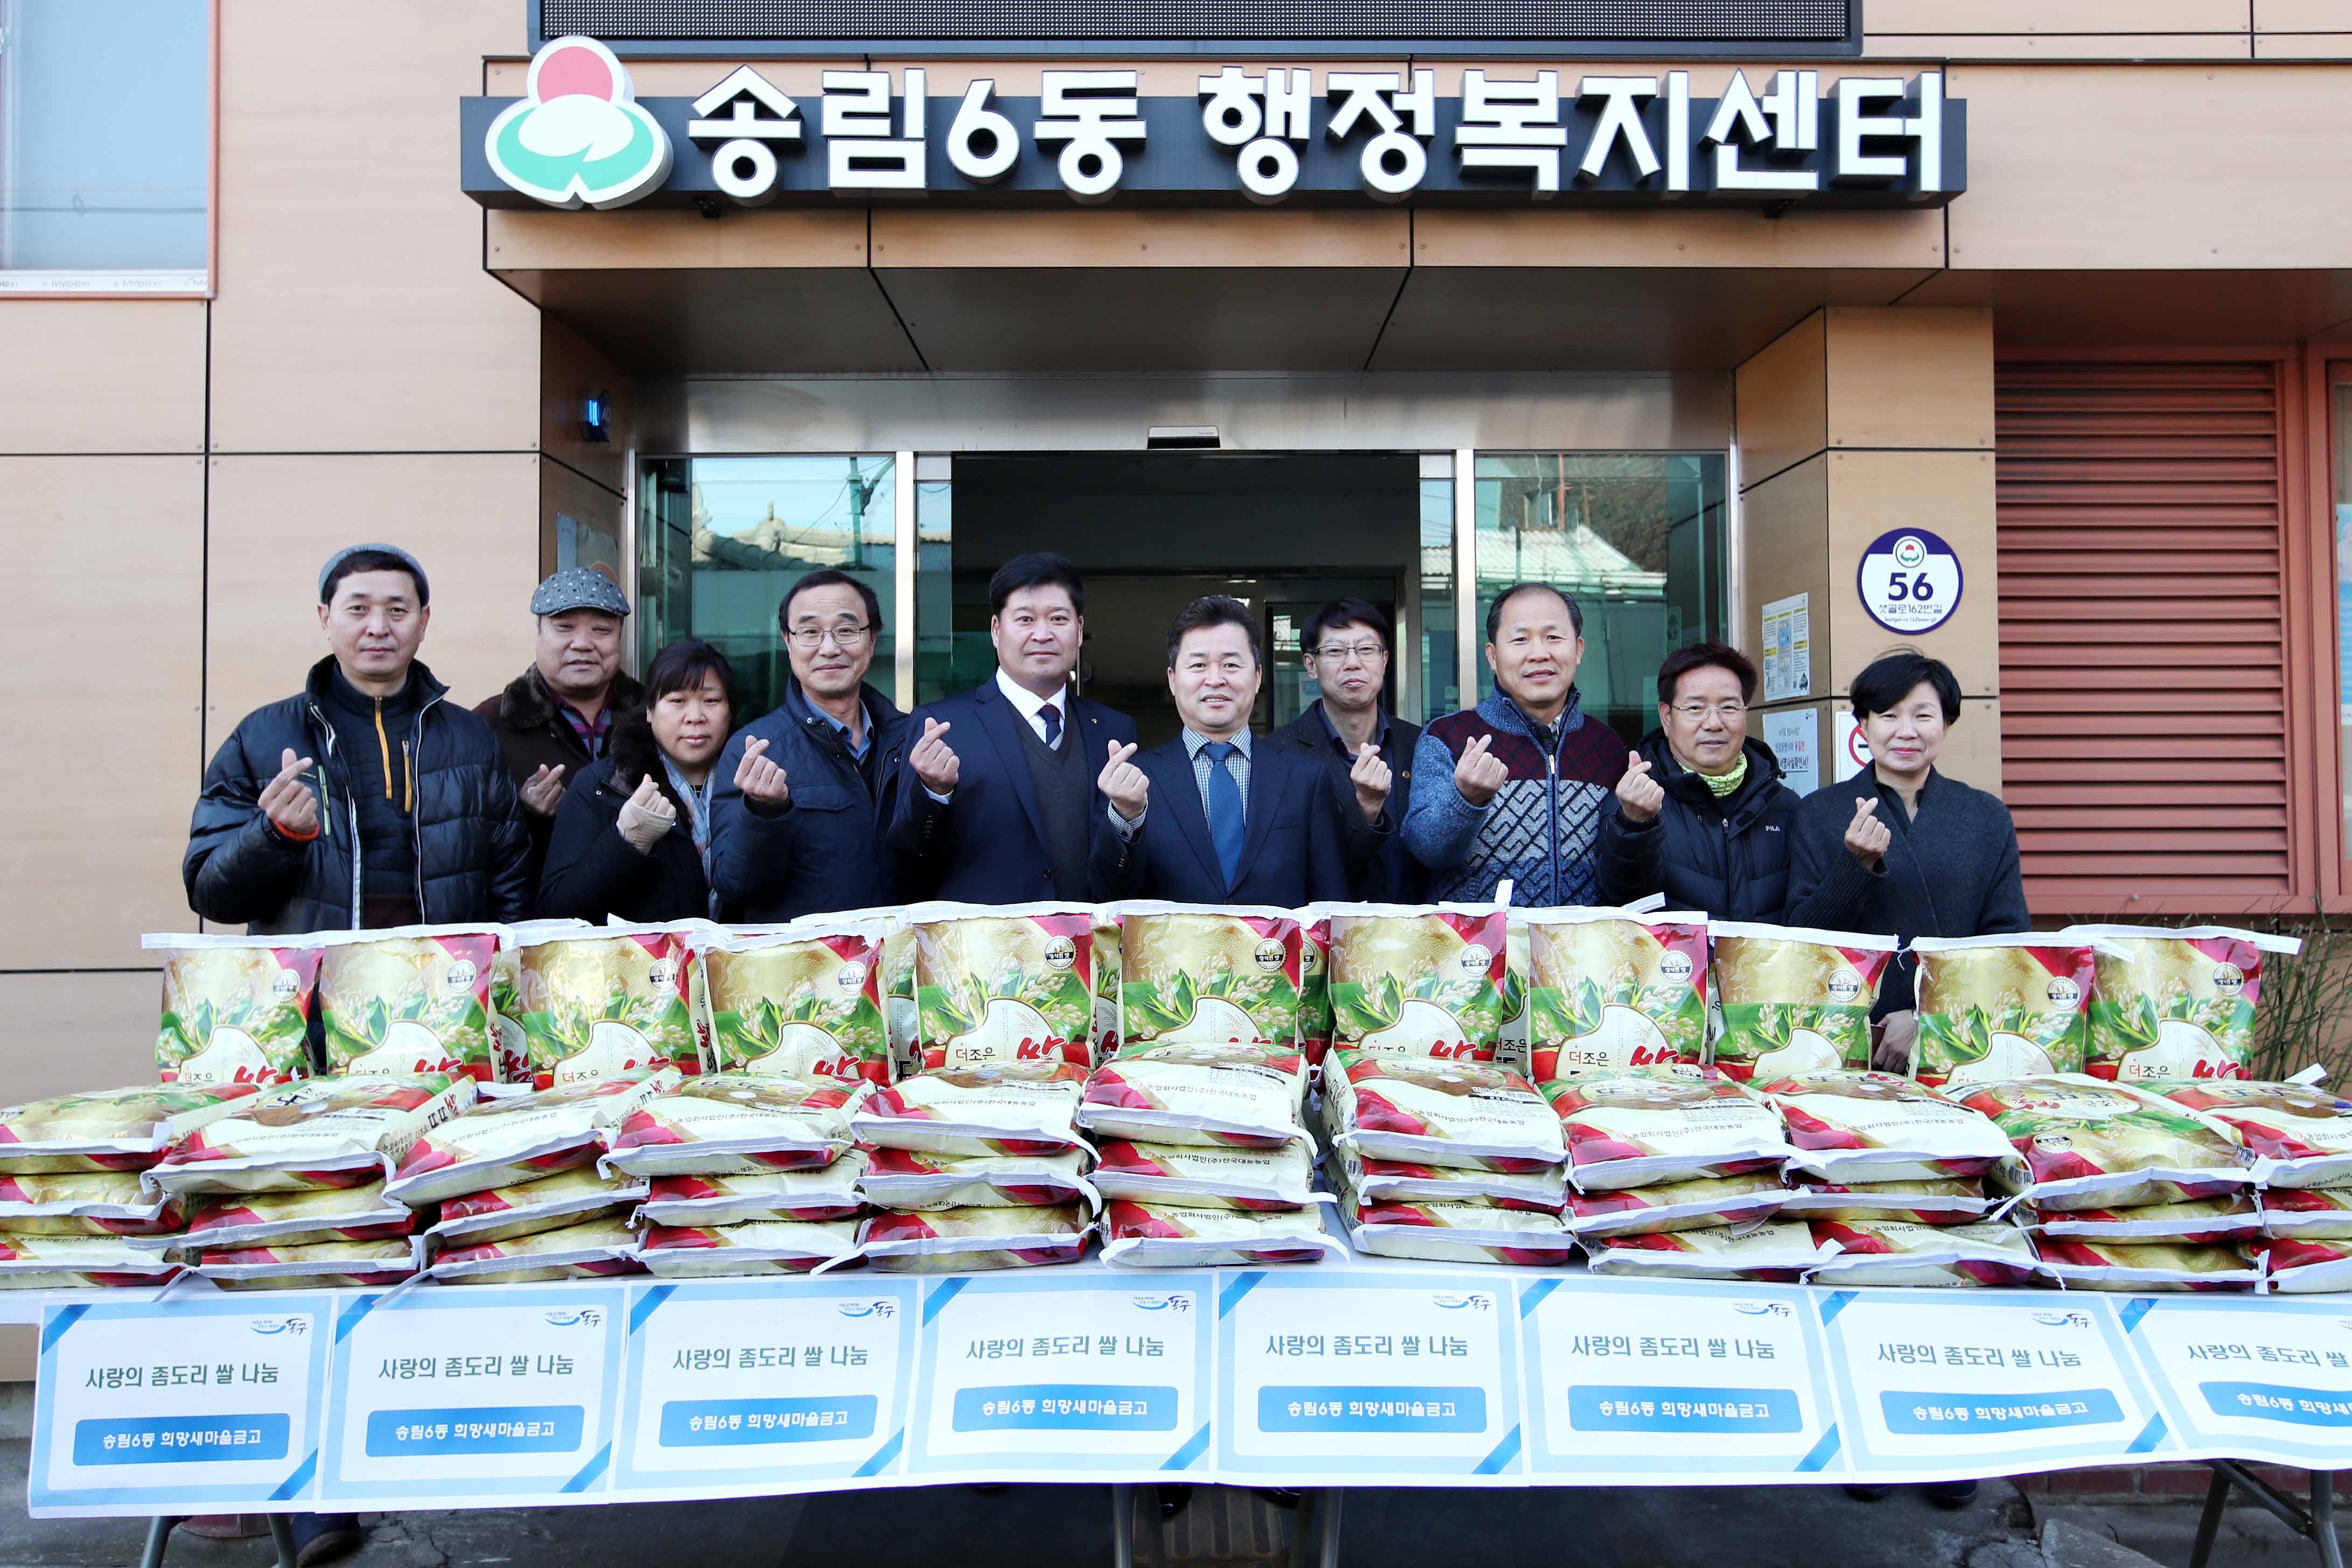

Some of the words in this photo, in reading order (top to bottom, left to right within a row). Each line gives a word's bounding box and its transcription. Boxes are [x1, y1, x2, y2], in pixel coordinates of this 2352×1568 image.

[687, 65, 1146, 199] 송림6동
[1198, 66, 1941, 195] 행정복지센터
[1888, 572, 1933, 601] 56
[1569, 1051, 1610, 1067] 더조은
[872, 1300, 895, 1319] 동구
[1167, 1294, 1191, 1312] 동구
[1467, 1294, 1491, 1311] 동구
[1767, 1303, 1792, 1318] 동구
[285, 1318, 309, 1335] 동구
[579, 1310, 603, 1327] 동구
[2066, 1312, 2091, 1328] 동구
[967, 1339, 1023, 1359] 사랑의
[1033, 1335, 1089, 1356] 좀도리
[1098, 1336, 1117, 1355] 쌀
[1126, 1336, 1163, 1356] 나눔
[1266, 1335, 1324, 1356] 사랑의
[1334, 1336, 1391, 1355] 좀도리
[1402, 1336, 1420, 1355] 쌀
[1430, 1336, 1467, 1356] 나눔
[1572, 1336, 1630, 1356] 사랑의
[1640, 1338, 1699, 1357] 좀도리
[1707, 1339, 1726, 1357] 쌀
[1735, 1340, 1774, 1359] 나눔
[674, 1348, 730, 1370] 사랑의
[739, 1347, 795, 1368] 좀도리
[804, 1347, 823, 1366] 쌀
[831, 1346, 867, 1366] 나눔
[1879, 1344, 1936, 1364] 사랑의
[1944, 1347, 2005, 1367] 좀도리
[2012, 1350, 2031, 1367] 쌀
[2039, 1351, 2081, 1367] 나눔
[2188, 1345, 2251, 1359] 사랑의
[2257, 1346, 2321, 1366] 좀도리
[2326, 1352, 2349, 1367] 쌀
[86, 1368, 142, 1388] 사랑의
[152, 1365, 207, 1386] 좀도리
[216, 1364, 234, 1384] 쌀
[242, 1363, 278, 1383] 나눔
[379, 1358, 436, 1379] 사랑의
[445, 1356, 501, 1377] 좀도리
[510, 1356, 529, 1375] 쌀
[537, 1355, 573, 1375] 나눔
[982, 1400, 1035, 1416] 송림6동
[1042, 1399, 1148, 1416] 희망새마을금고
[1288, 1402, 1342, 1417] 송림6동
[1349, 1402, 1456, 1417] 희망새마을금고
[1600, 1401, 1654, 1416] 송림6동
[1661, 1402, 1770, 1418] 희망새마을금고
[1913, 1406, 1969, 1421] 송림6동
[1975, 1402, 2089, 1420] 희망새마을금고
[2237, 1394, 2293, 1411] 송림6동
[689, 1415, 741, 1431] 송림6동
[747, 1411, 849, 1429] 희망새마을금고
[103, 1433, 155, 1450] 송림6동
[161, 1430, 261, 1447] 희망새마을금고
[396, 1424, 448, 1440] 송림6동
[454, 1422, 554, 1438] 희망새마을금고
